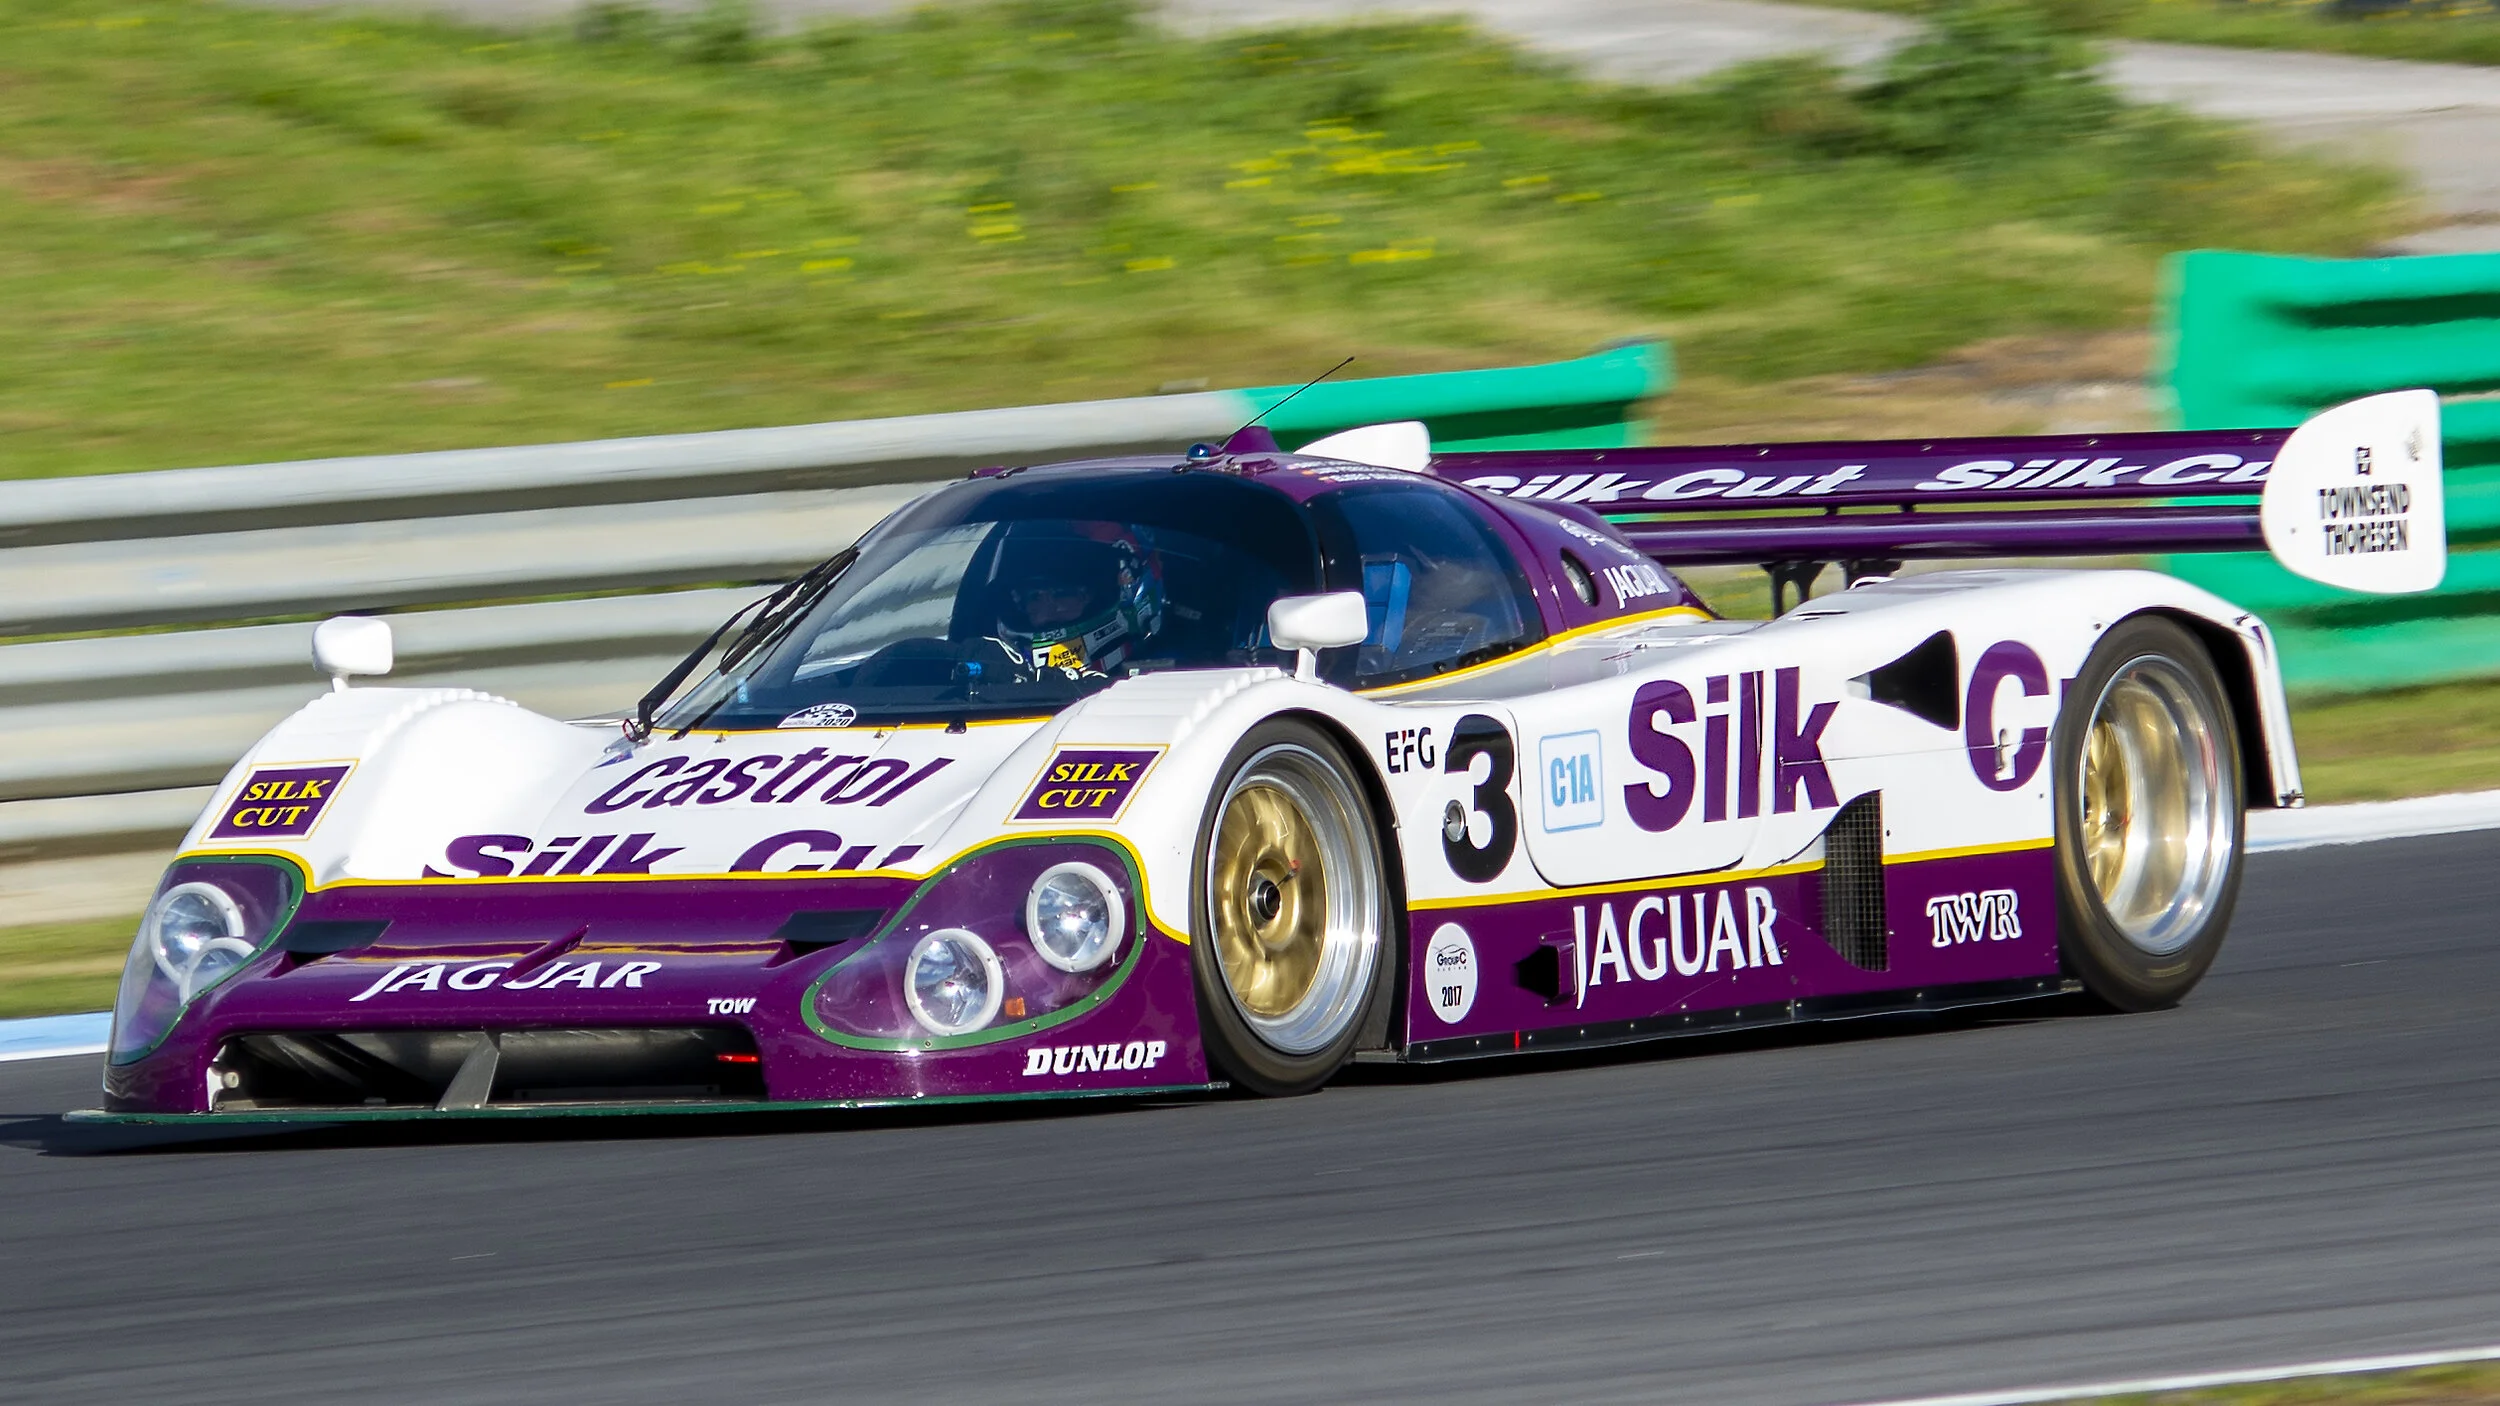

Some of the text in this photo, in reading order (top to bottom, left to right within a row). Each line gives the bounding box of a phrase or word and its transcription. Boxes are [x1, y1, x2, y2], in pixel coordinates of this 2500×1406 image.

[1642, 464, 1868, 501] Cut
[1914, 457, 2147, 491] Silk
[2318, 483, 2410, 519] TOWNSEND
[2323, 519, 2409, 556] THORESEN
[1385, 726, 1436, 775] EFG
[1623, 639, 2080, 833] Silk C
[242, 779, 332, 801] SILK
[583, 746, 956, 815] Castrol
[1047, 763, 1140, 783] SILK
[1550, 753, 1596, 808] C1A
[232, 805, 310, 827] CUT
[1037, 788, 1117, 809] CUT
[1441, 713, 1519, 884] 3
[1925, 888, 2023, 948] TWR
[1572, 886, 1784, 1010] JAGUAR
[349, 961, 663, 1002] JAGUAR
[1441, 985, 1463, 1007] 2017
[706, 997, 757, 1015] TOW
[1021, 1040, 1167, 1077] DUNLOP
